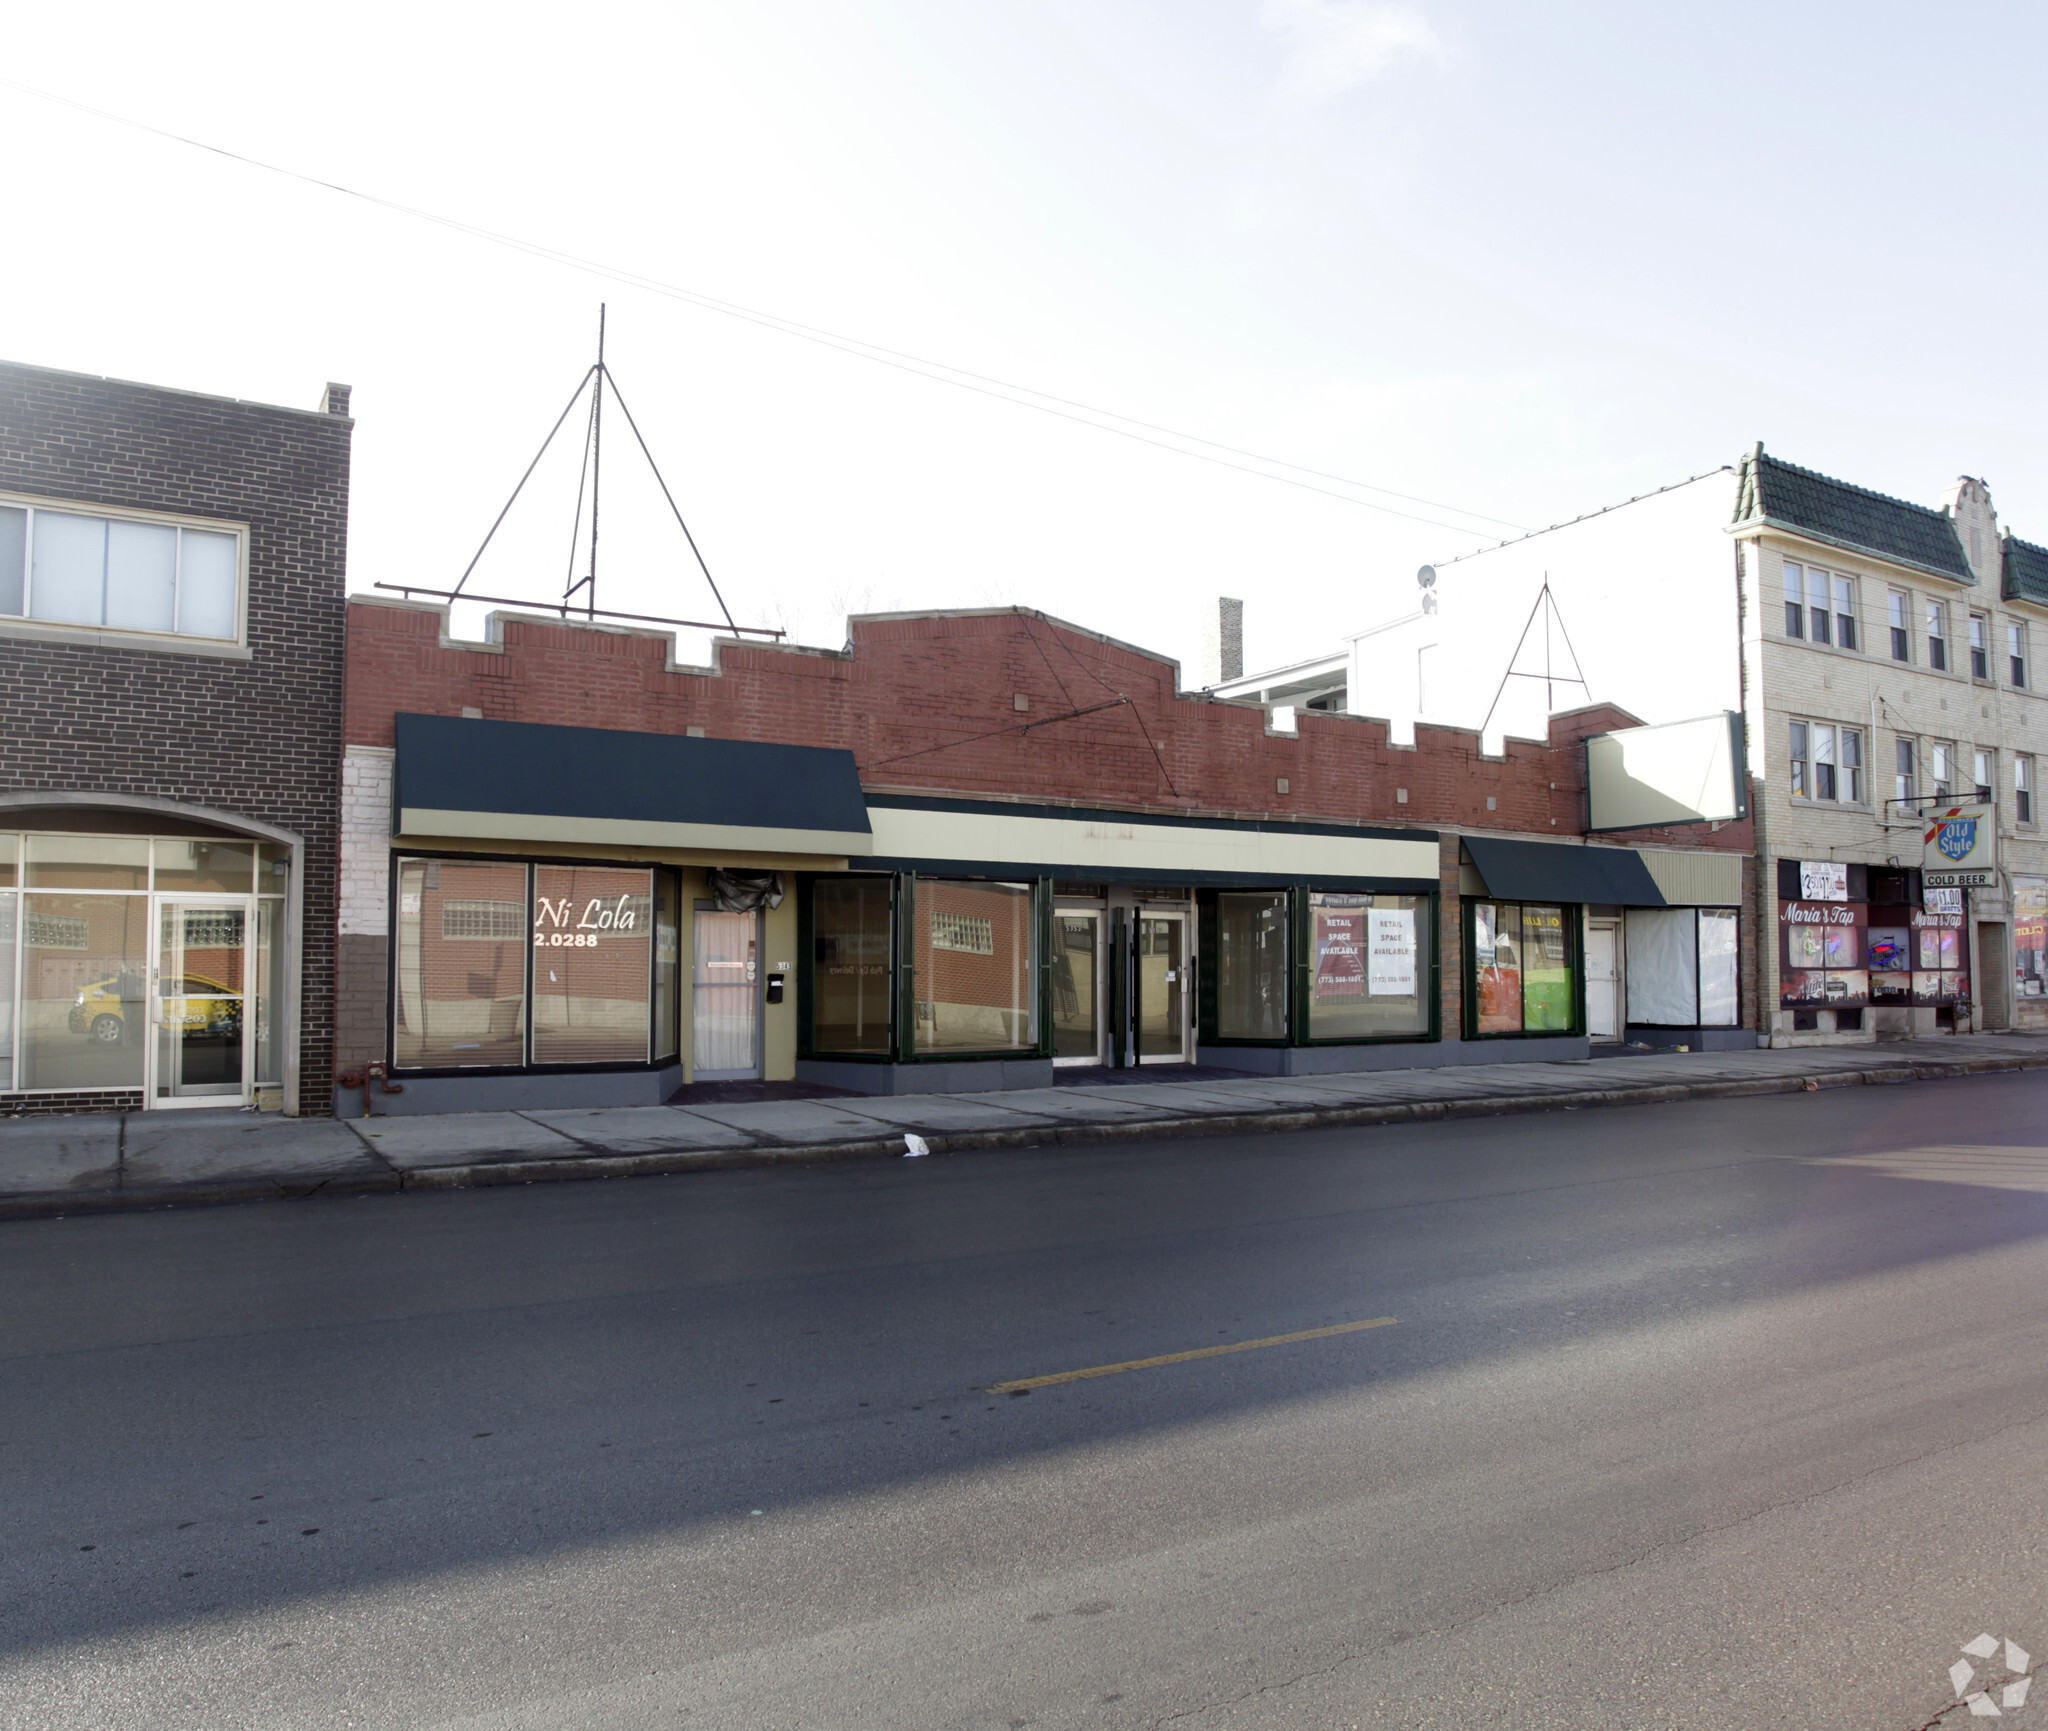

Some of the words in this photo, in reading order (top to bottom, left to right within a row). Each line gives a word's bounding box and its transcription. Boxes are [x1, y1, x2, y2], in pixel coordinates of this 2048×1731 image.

[1946, 822, 1969, 838] Old
[1940, 838, 1973, 857] Style
[1928, 876, 1955, 885] COLD
[1958, 875, 1986, 885] BEER
[1938, 890, 1960, 905] $1.00
[535, 897, 572, 928] Ni
[576, 894, 635, 930] Lola
[1780, 903, 1829, 924] Maria's
[1829, 906, 1854, 926] Tap
[1911, 910, 1944, 927] Marias
[1326, 919, 1352, 927] RETAIL
[1379, 920, 1403, 928] RETAIL
[534, 933, 598, 947] 2.0288
[1320, 946, 1358, 955] AVAILABLE
